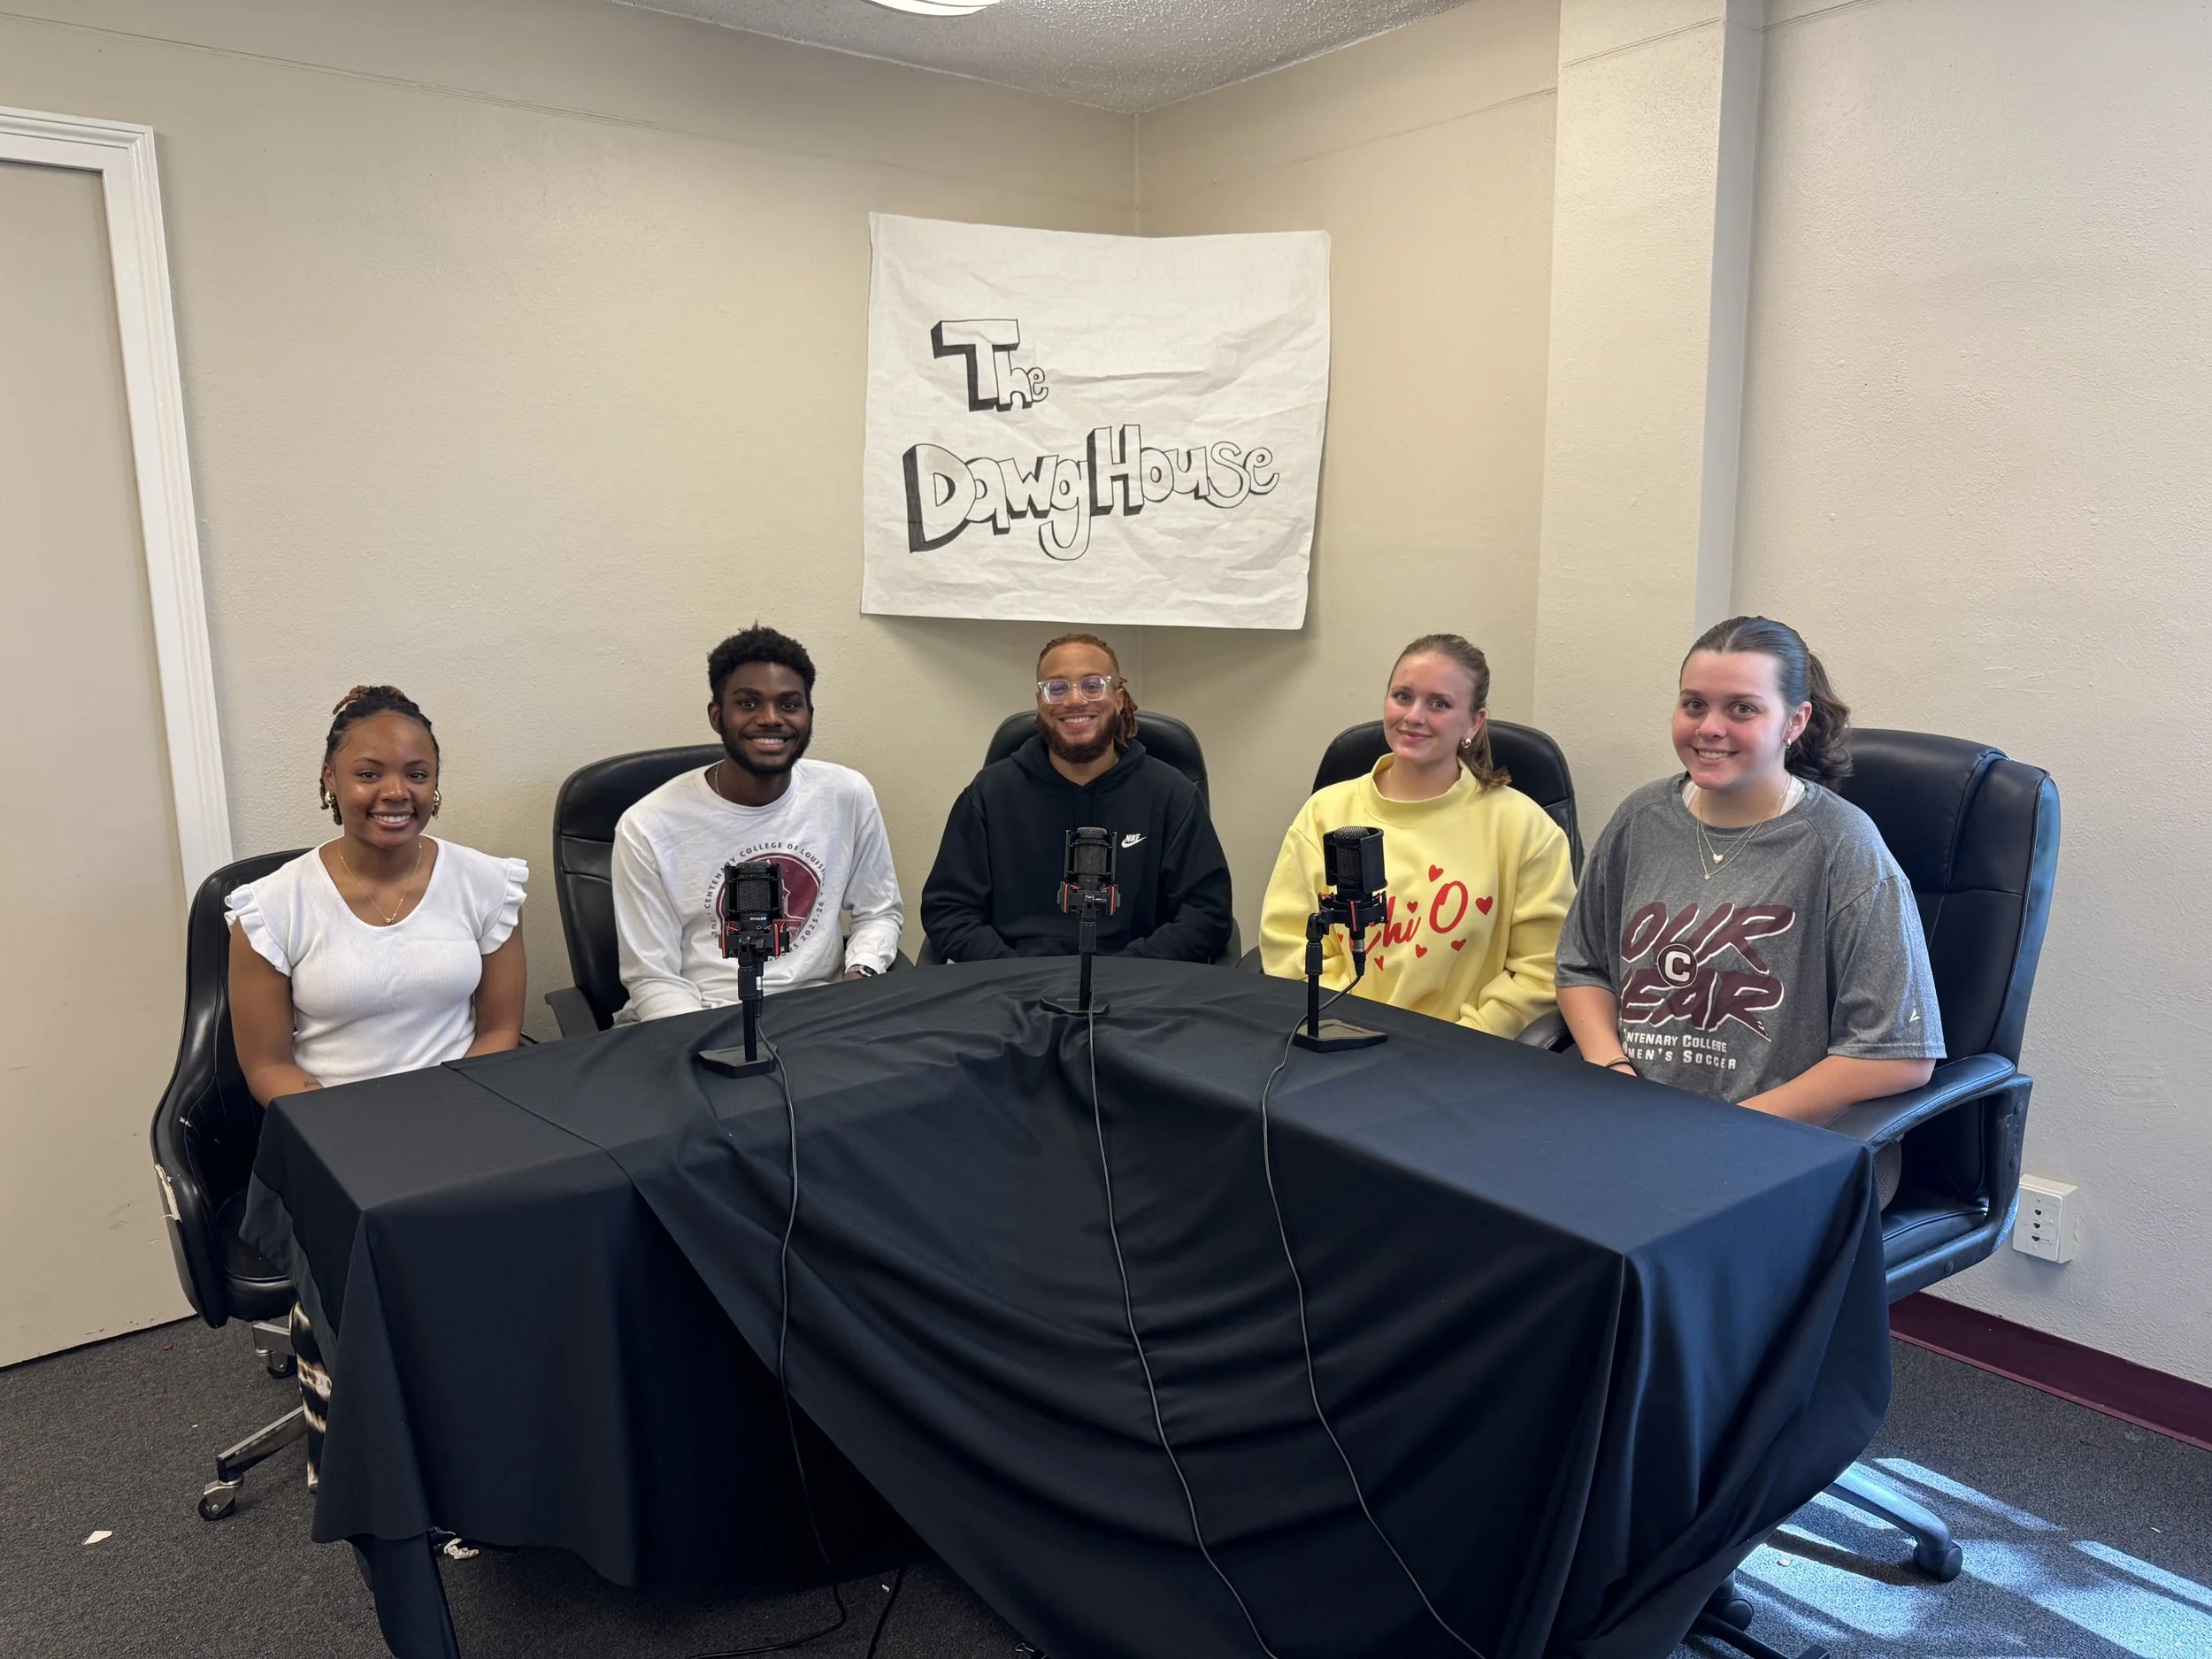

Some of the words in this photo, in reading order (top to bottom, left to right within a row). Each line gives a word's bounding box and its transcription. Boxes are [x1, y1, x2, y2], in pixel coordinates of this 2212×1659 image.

[931, 319, 1048, 412] The
[902, 424, 1279, 561] DawgHouse
[740, 842, 783, 857] COLLEGE
[801, 901, 825, 942] 2025-26
[1429, 880, 1469, 933] O
[1621, 901, 1796, 975] OUR
[1664, 950, 1692, 982] C
[1621, 966, 1785, 1043] EAR
[1623, 1028, 1678, 1047] NTENARY
[1682, 1034, 1727, 1053] COLLEGE
[1683, 1049, 1737, 1070] SOCCER
